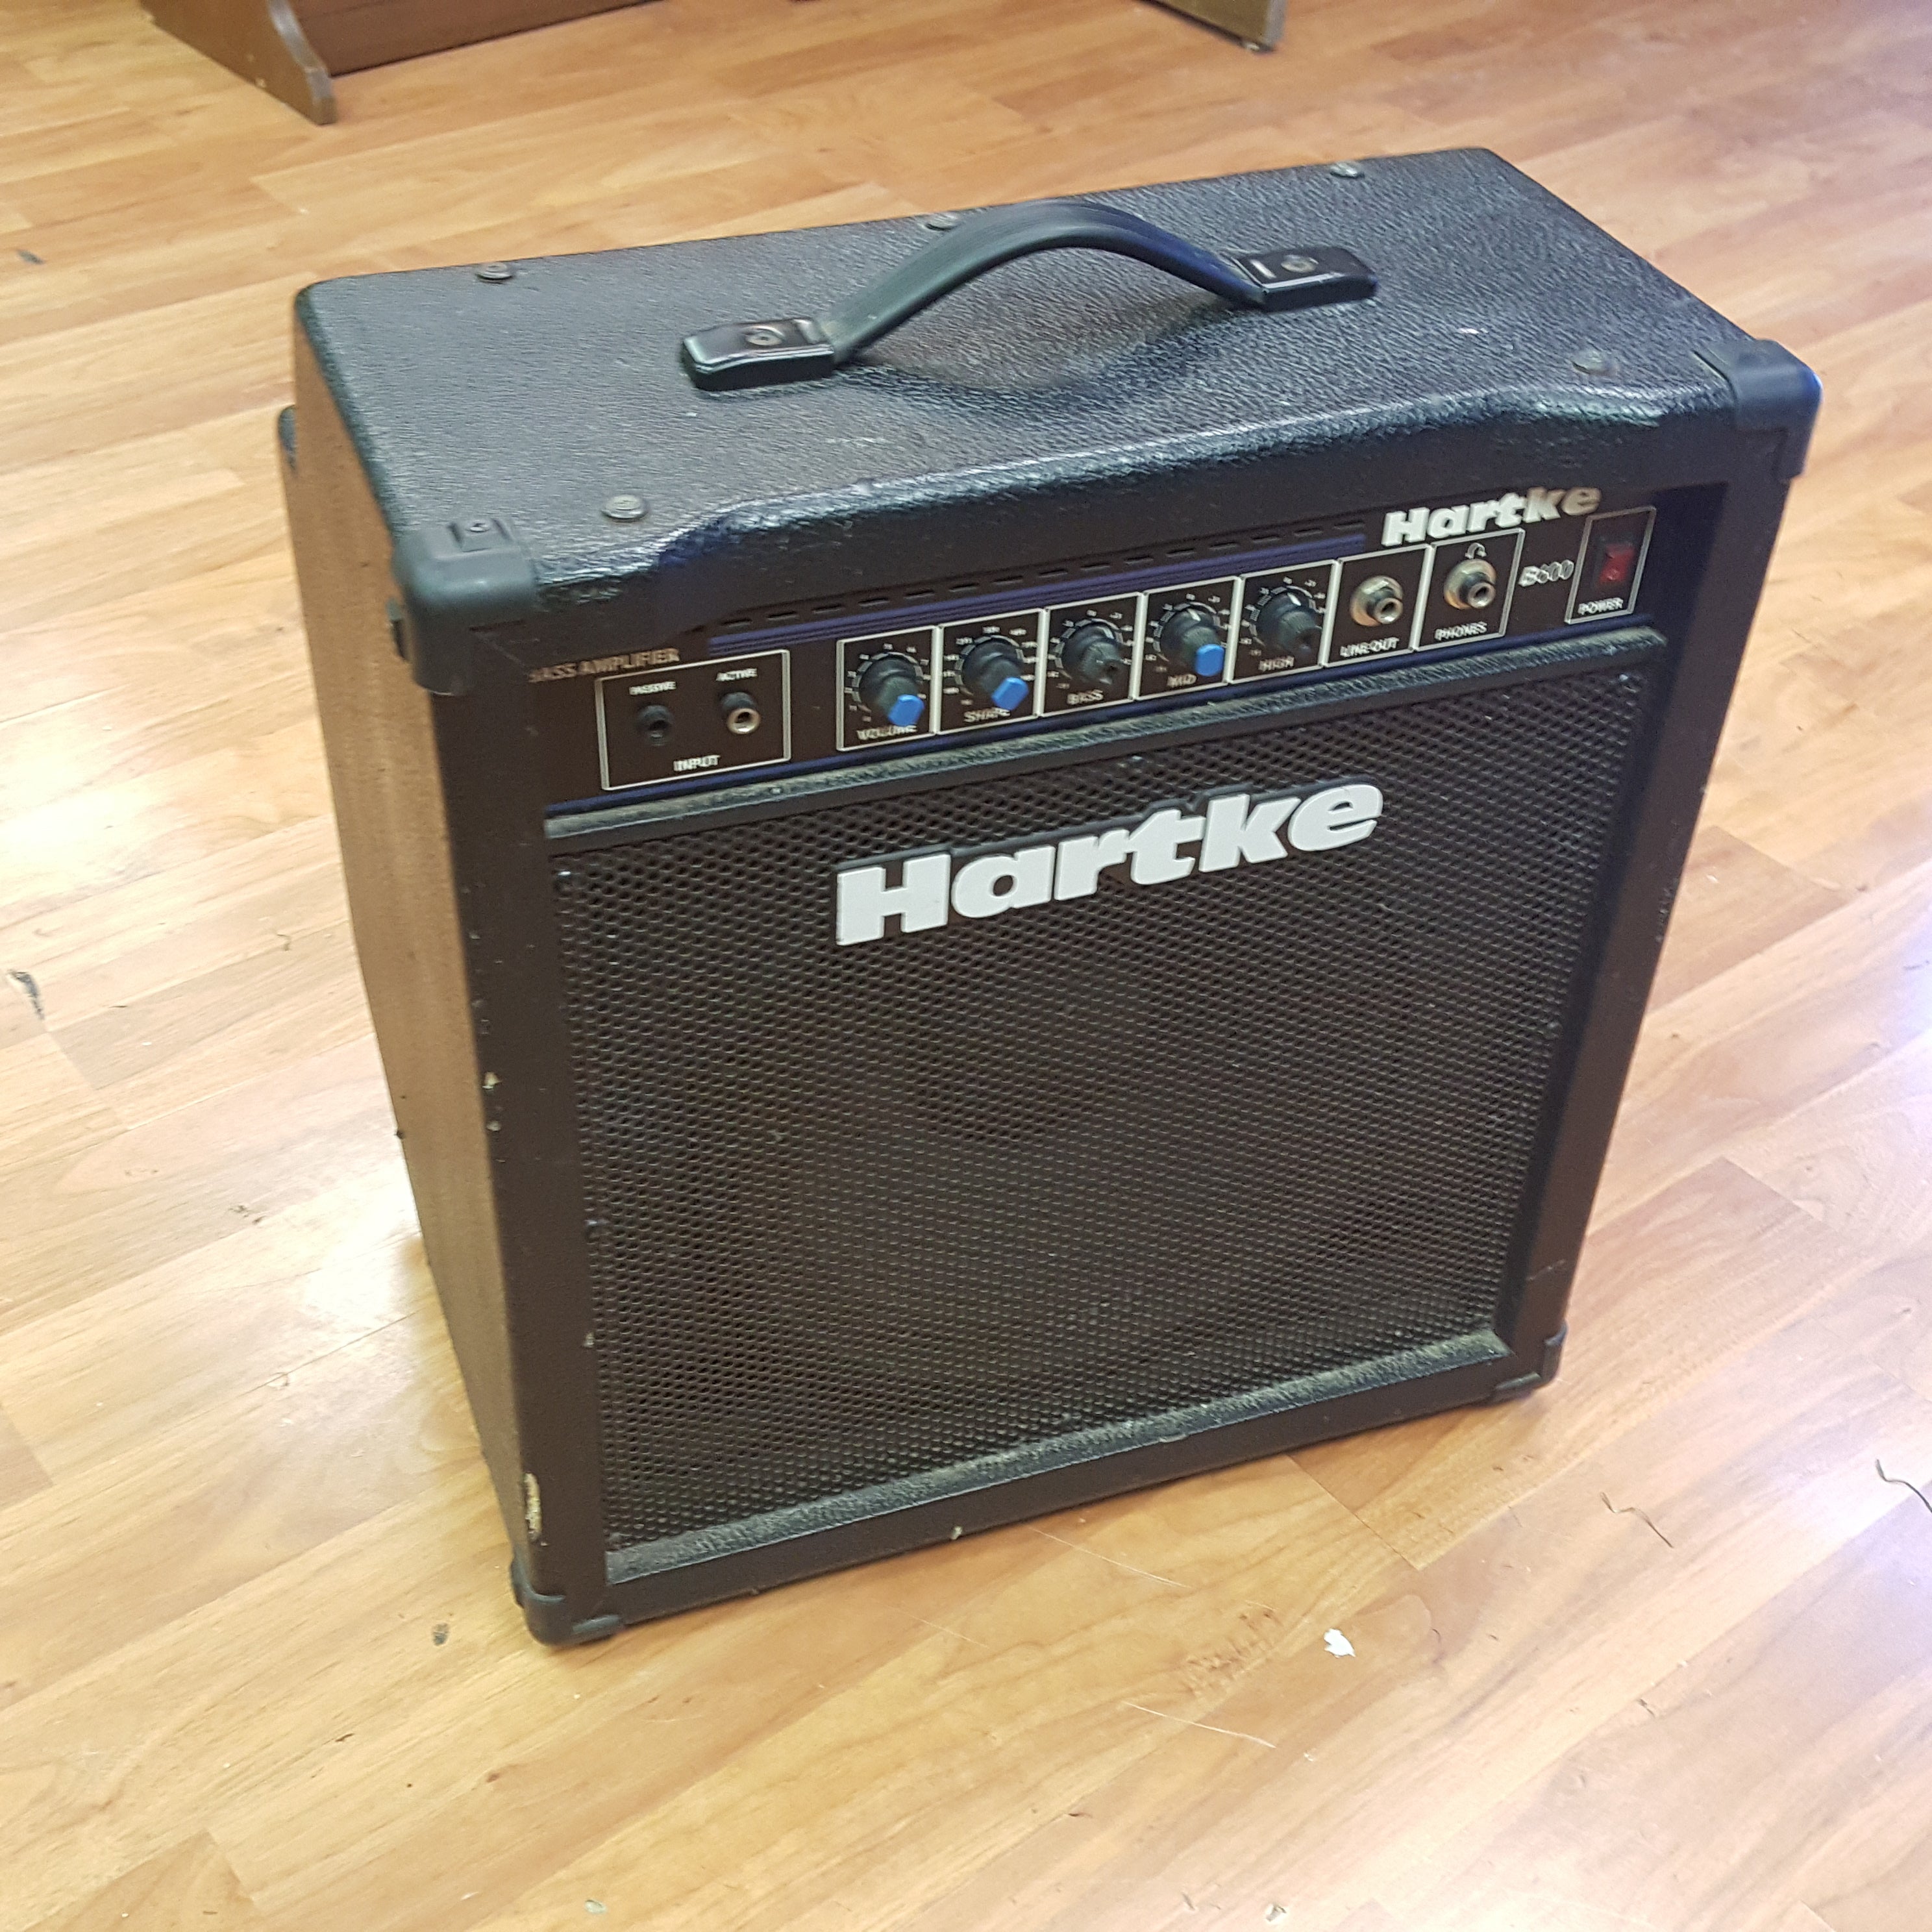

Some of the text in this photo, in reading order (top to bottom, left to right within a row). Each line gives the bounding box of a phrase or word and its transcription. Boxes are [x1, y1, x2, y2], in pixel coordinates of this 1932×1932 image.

[1381, 487, 1601, 546] Hartke
[1578, 597, 1624, 615] POWER
[1435, 621, 1487, 640] PHONES
[1369, 637, 1399, 651] OUT
[578, 648, 680, 675] AMPLIFIER
[1259, 656, 1294, 671] HIGH
[716, 668, 757, 681] ACTIVE
[1167, 674, 1196, 687] MID
[1067, 689, 1104, 705] BASS
[673, 755, 720, 771] INPUT
[836, 784, 1384, 947] Hartke
